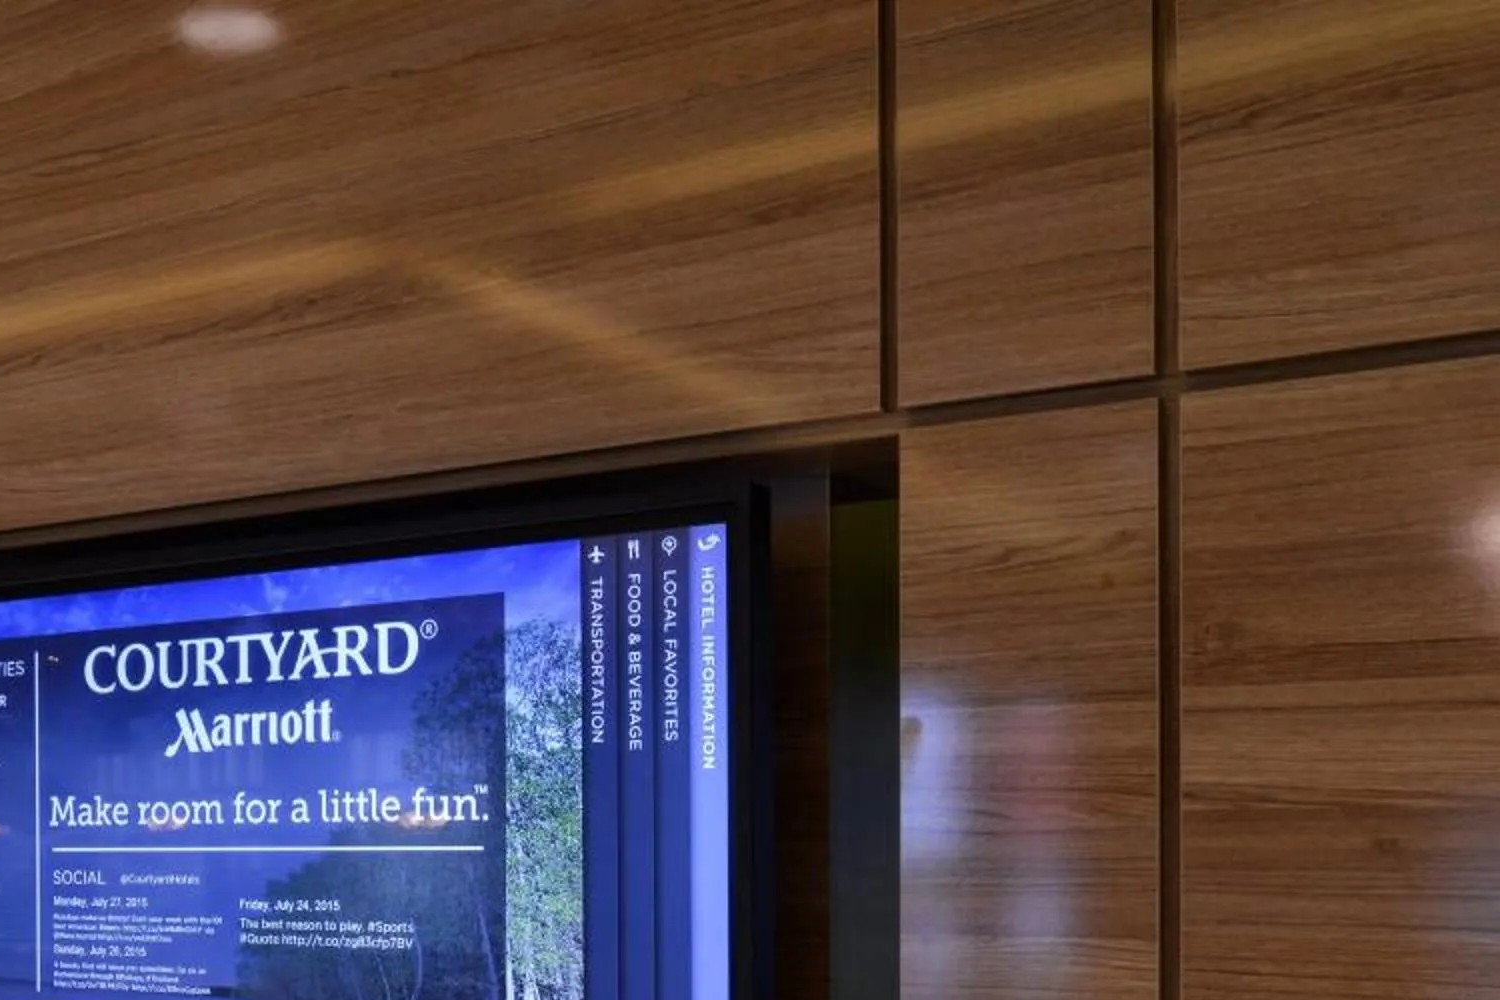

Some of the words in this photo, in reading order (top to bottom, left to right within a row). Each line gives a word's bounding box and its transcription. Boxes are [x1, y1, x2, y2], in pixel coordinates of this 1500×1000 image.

[627, 573, 642, 627] FOOD
[663, 569, 677, 632] LOCAL
[700, 567, 715, 629] HOTEL
[590, 576, 605, 744] TRANSPORTATION
[628, 632, 641, 645] &
[628, 651, 643, 751] BEVERAGE
[663, 639, 679, 742] FAVORITES
[701, 635, 716, 769] INFORMATION
[49, 795, 129, 826] Make
[137, 799, 225, 826] room
[232, 791, 282, 824] for
[290, 798, 311, 823] a
[319, 788, 400, 823] little
[53, 870, 106, 885] SOCIAL
[274, 899, 294, 913] July
[315, 900, 341, 912] 2015
[240, 918, 259, 929] The
[261, 919, 284, 930] best
[285, 921, 323, 931] reason
[324, 920, 338, 931] to
[367, 921, 415, 934] #Sports
